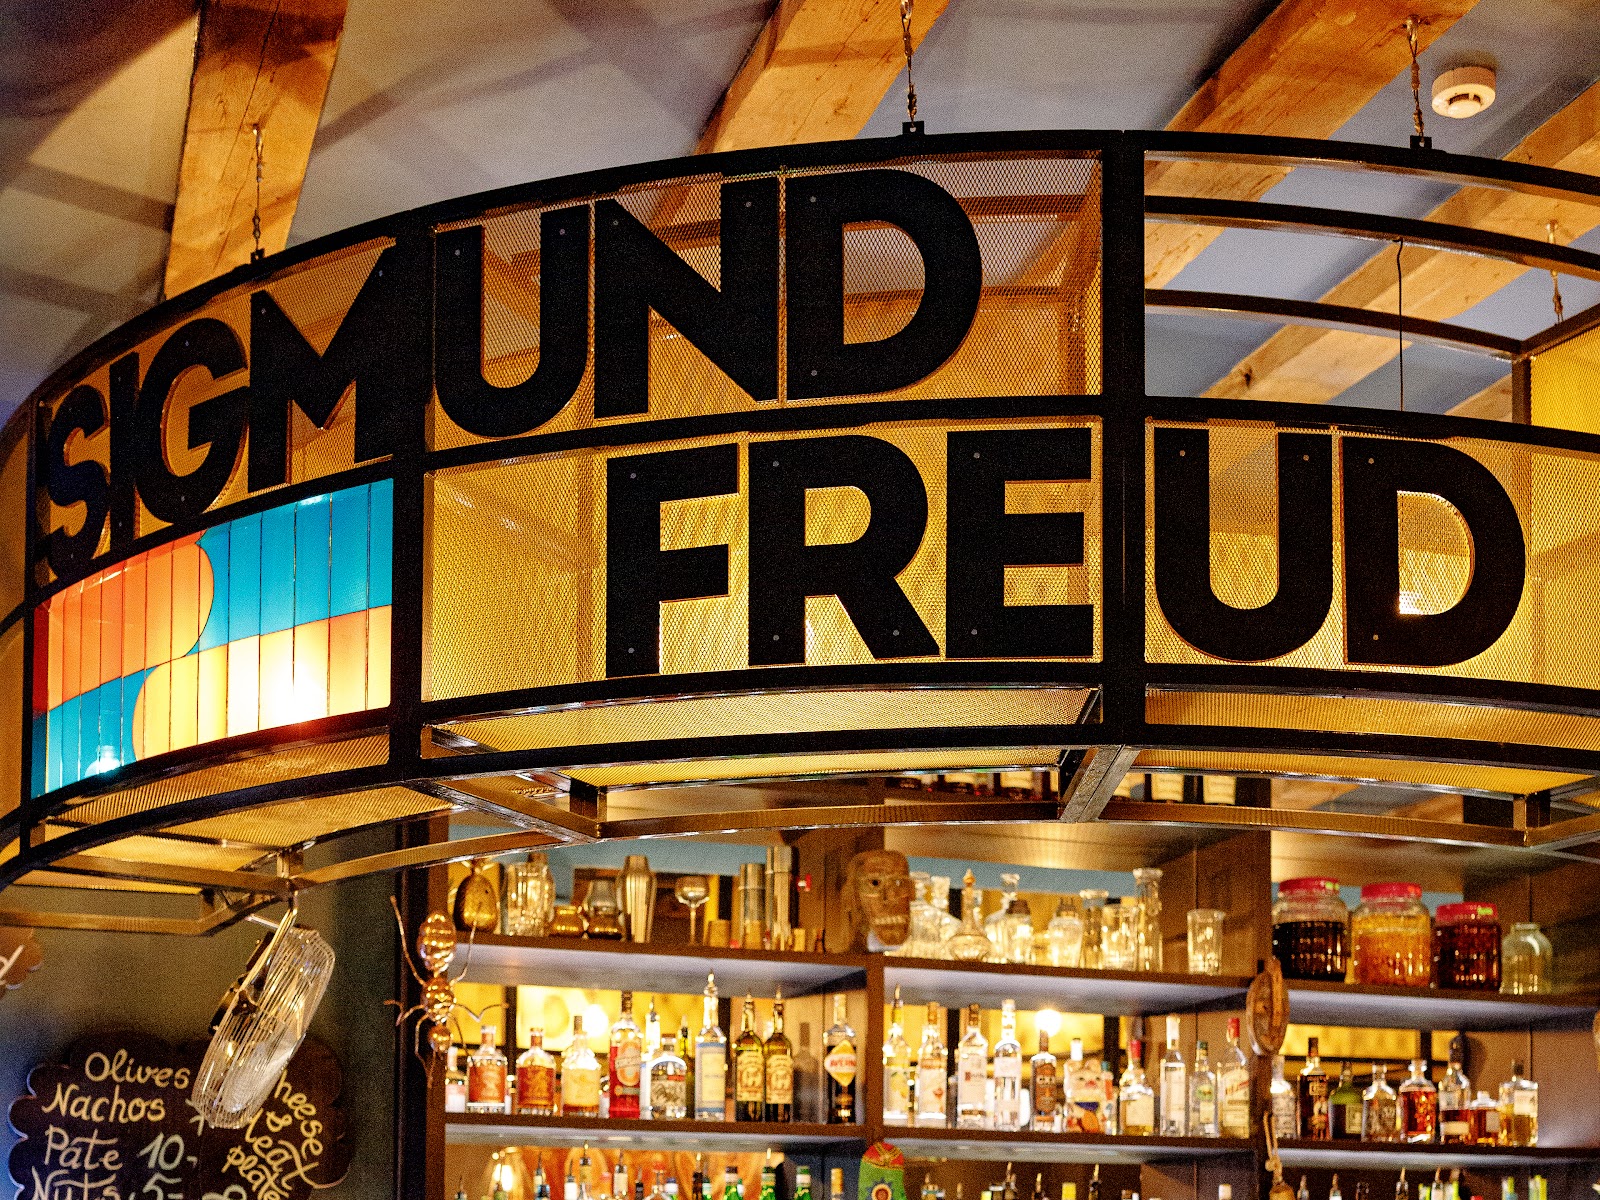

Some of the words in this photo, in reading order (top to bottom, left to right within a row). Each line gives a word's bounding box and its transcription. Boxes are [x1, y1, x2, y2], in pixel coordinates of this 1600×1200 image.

[46, 166, 982, 574] SIGMUND
[606, 426, 1527, 679] FREUD
[41, 1082, 166, 1124] Nachos
[85, 1049, 191, 1089] Olives
[44, 1124, 123, 1171] Pate
[272, 1070, 324, 1162] heese
